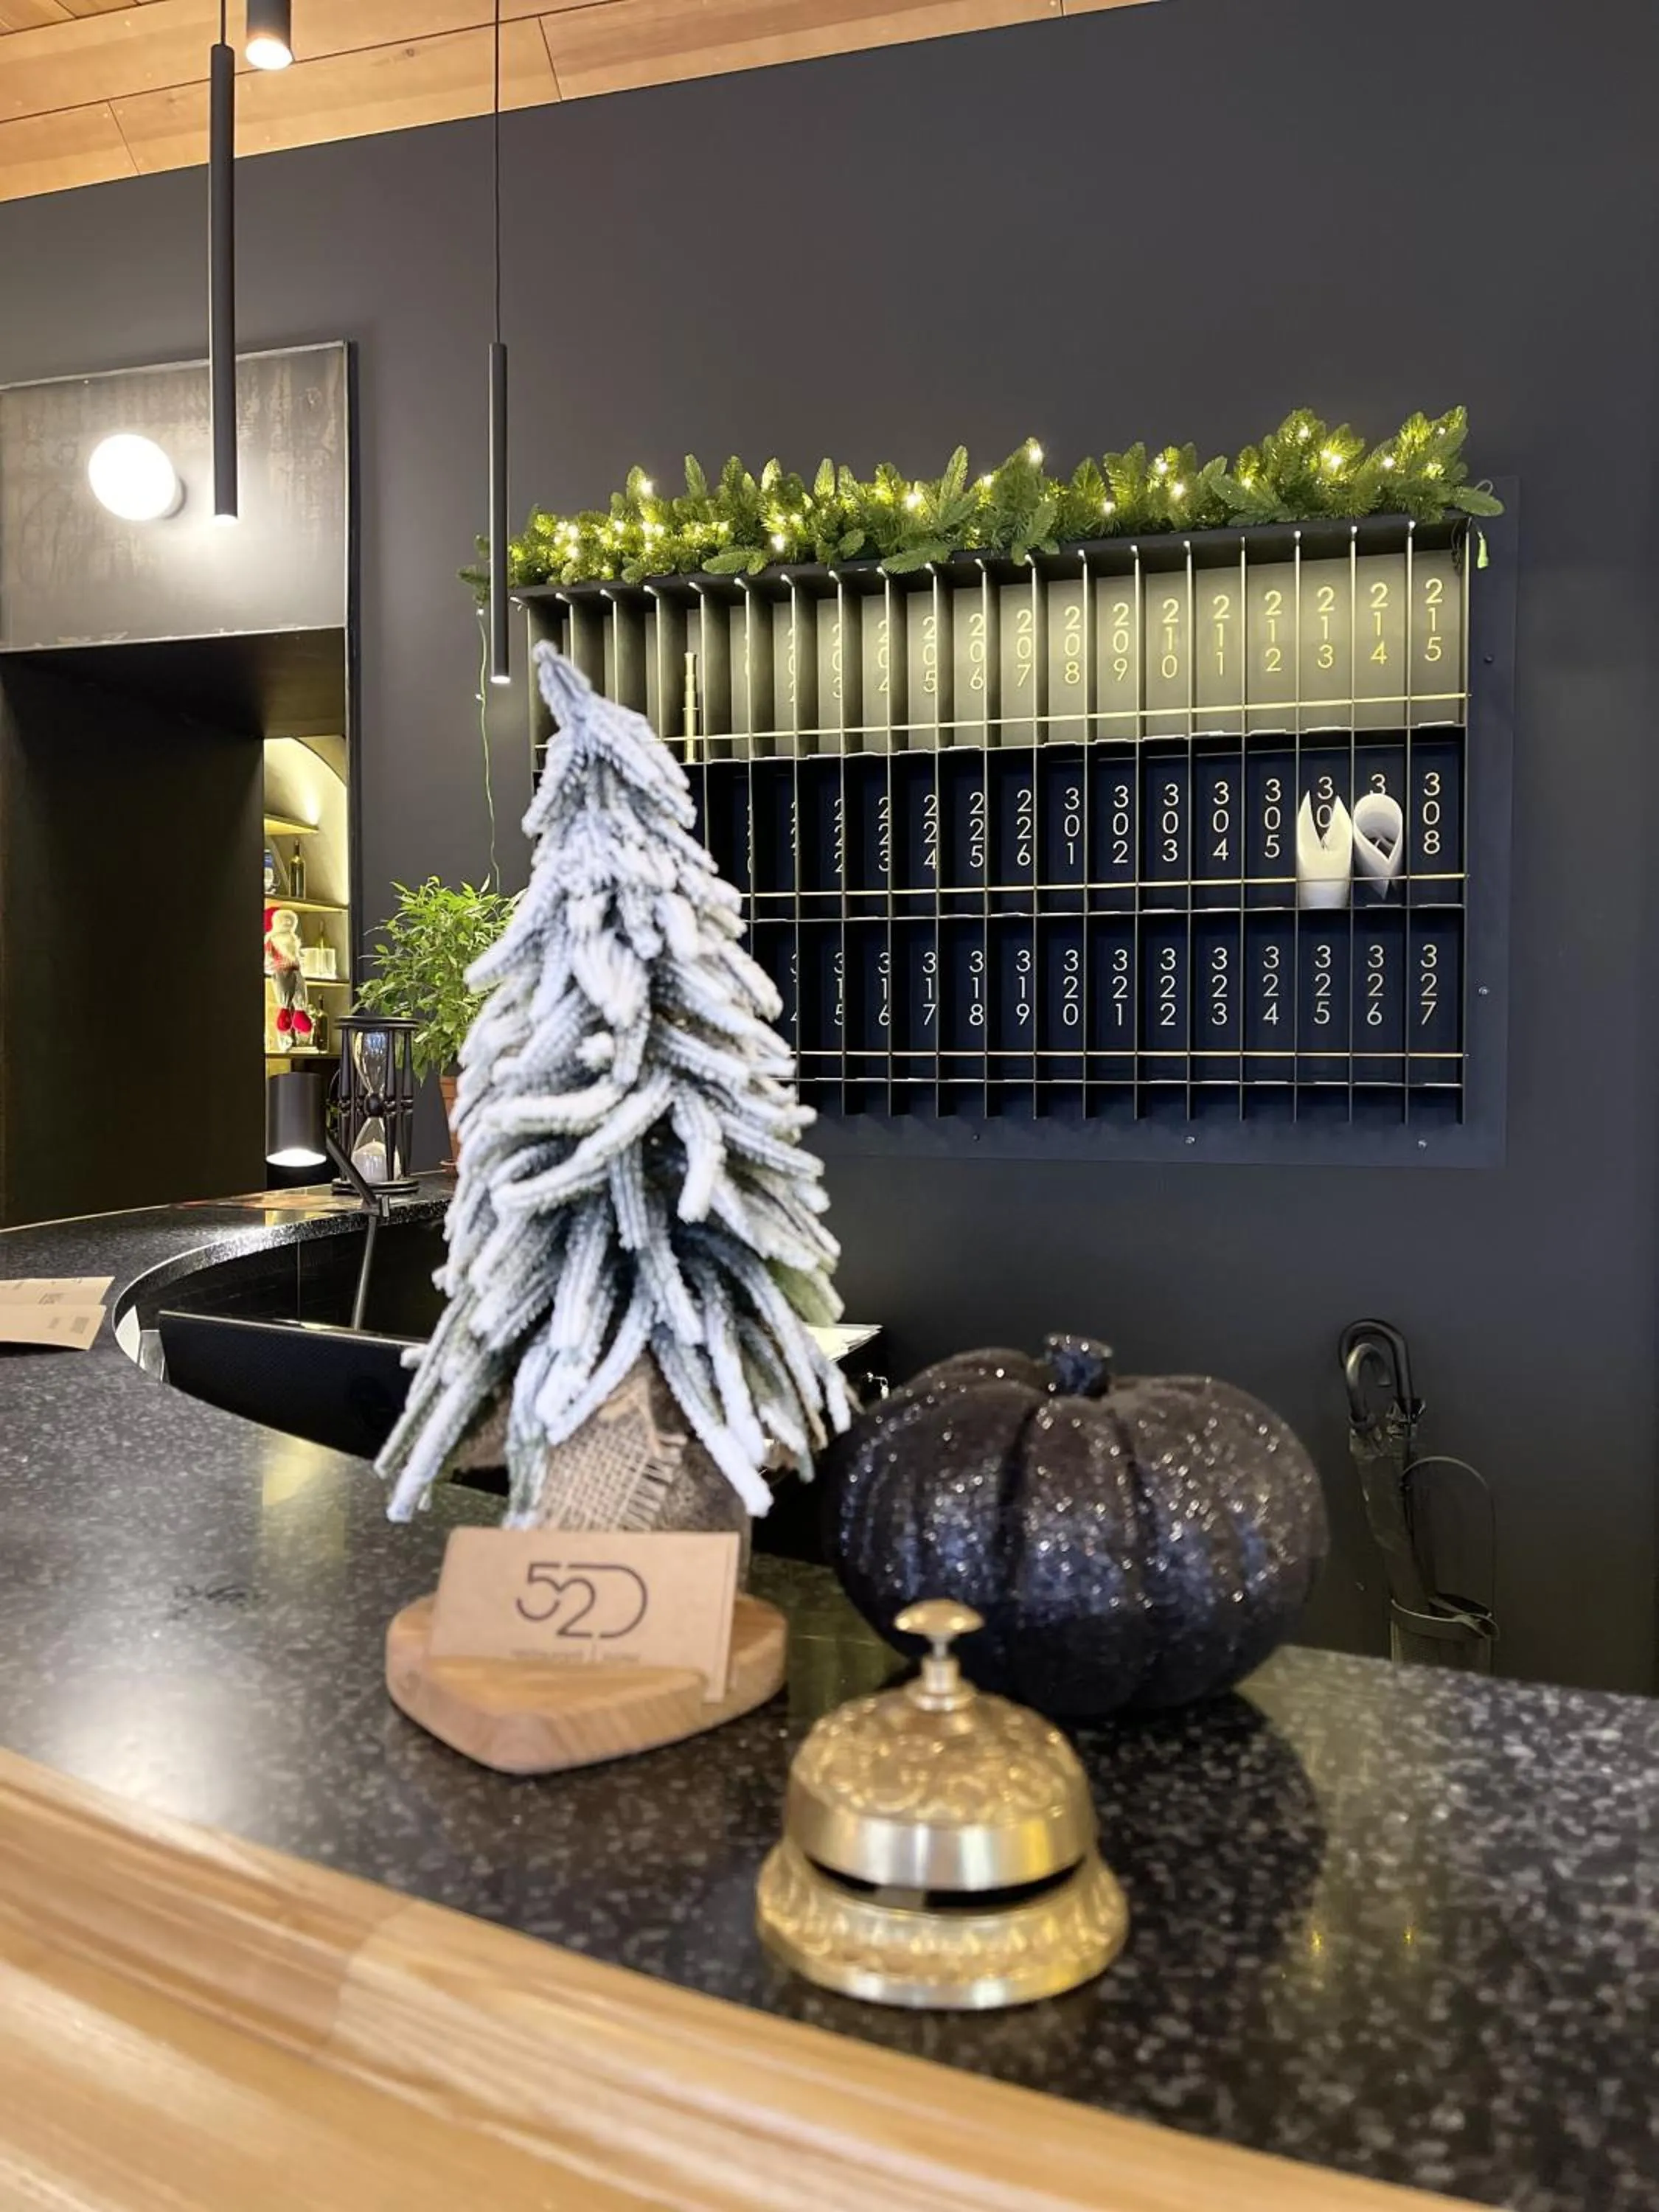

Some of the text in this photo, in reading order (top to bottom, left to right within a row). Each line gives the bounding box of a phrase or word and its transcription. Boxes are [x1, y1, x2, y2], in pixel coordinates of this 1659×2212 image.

[922, 616, 936, 692] 205
[969, 613, 984, 689] 206
[1017, 609, 1032, 686] 207
[1064, 605, 1081, 684] 208
[1113, 602, 1130, 681] 209
[1161, 598, 1179, 678] 210
[1213, 595, 1231, 675] 211
[1265, 591, 1282, 672] 212
[1317, 587, 1335, 669] 213
[1371, 582, 1388, 664] 214
[1425, 578, 1443, 661] 215
[924, 794, 937, 869] 224
[970, 791, 984, 868] 225
[1017, 790, 1032, 866] 226
[1064, 787, 1079, 865] 301
[1113, 785, 1129, 863] 302
[1163, 784, 1179, 862] 303
[1213, 781, 1229, 860] 304
[1265, 778, 1281, 858] 305
[1422, 772, 1440, 855] 308
[878, 952, 890, 1026] 316
[922, 952, 936, 1026] 317
[969, 950, 984, 1026] 318
[1015, 949, 1031, 1026] 319
[1063, 949, 1079, 1026] 320
[1112, 949, 1128, 1026] 321
[1160, 947, 1176, 1026] 322
[1211, 947, 1228, 1025] 323
[1262, 946, 1279, 1026] 324
[1313, 945, 1331, 1024] 325
[1366, 945, 1384, 1026] 326
[1420, 944, 1438, 1026] 327
